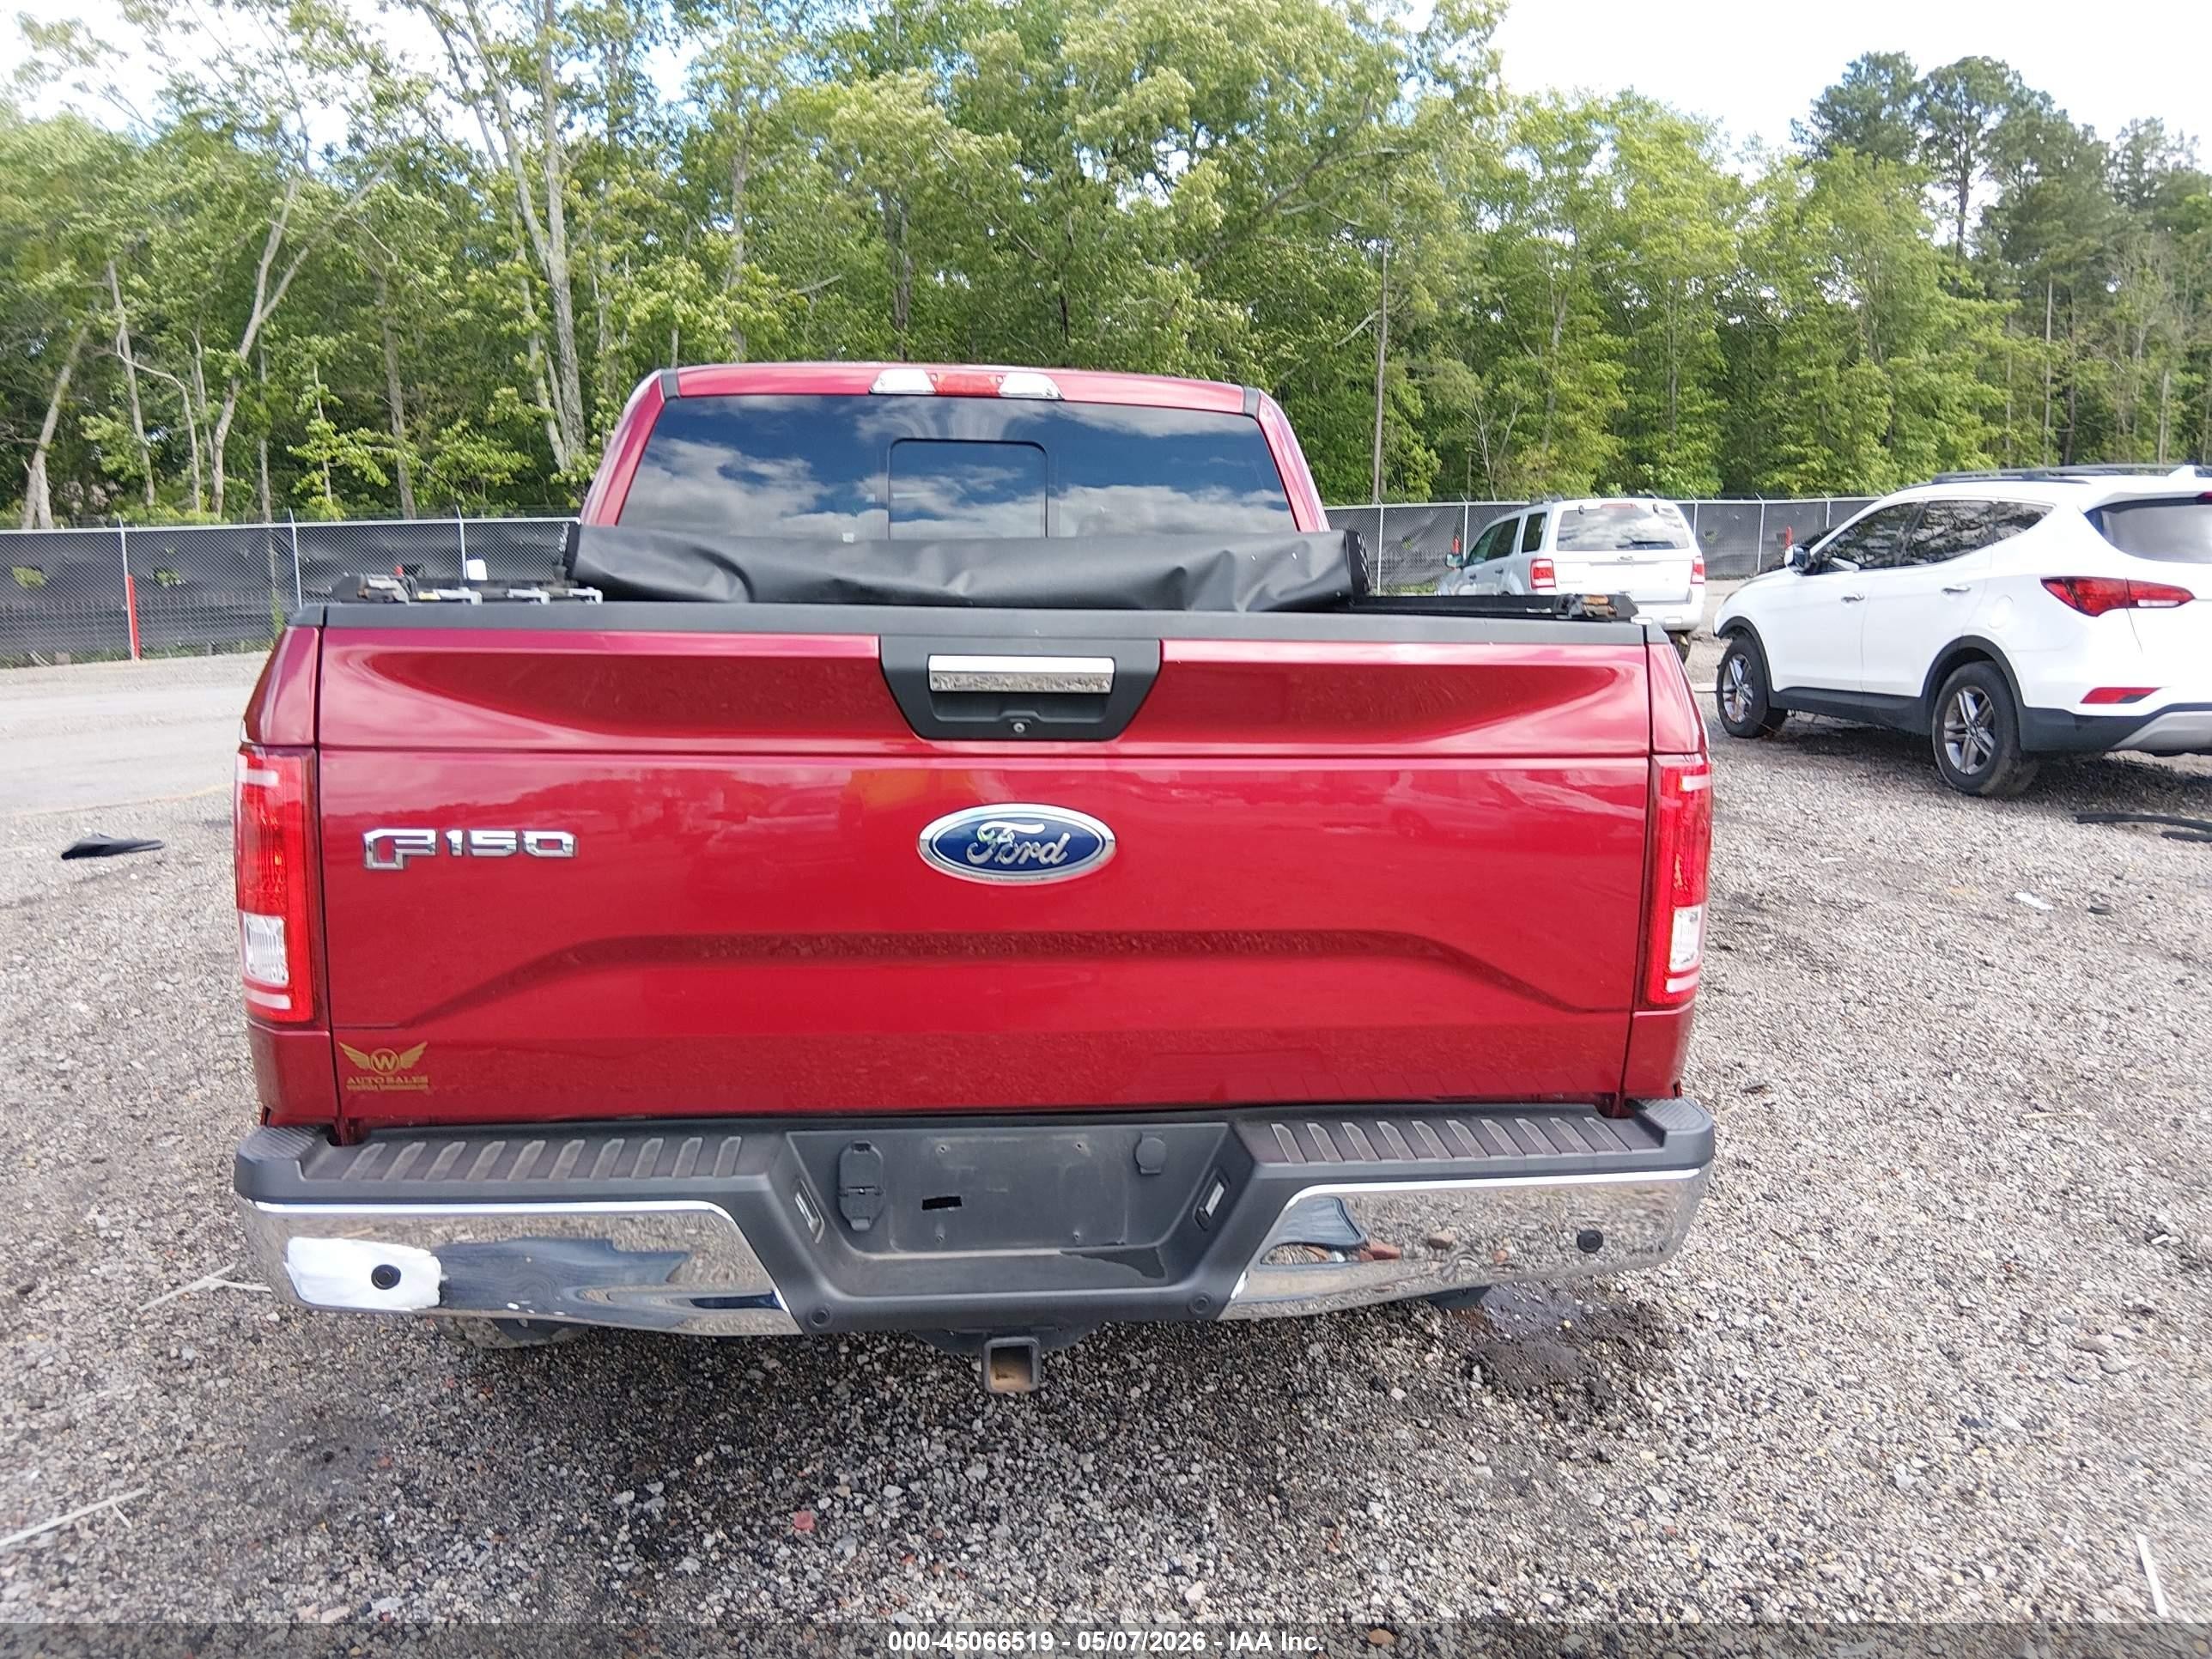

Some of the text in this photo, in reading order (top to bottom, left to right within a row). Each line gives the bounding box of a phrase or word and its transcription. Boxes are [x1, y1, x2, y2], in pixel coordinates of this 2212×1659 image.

[967, 821, 1071, 865] Ford
[374, 1054, 397, 1071] W
[346, 1076, 384, 1085] AUTO
